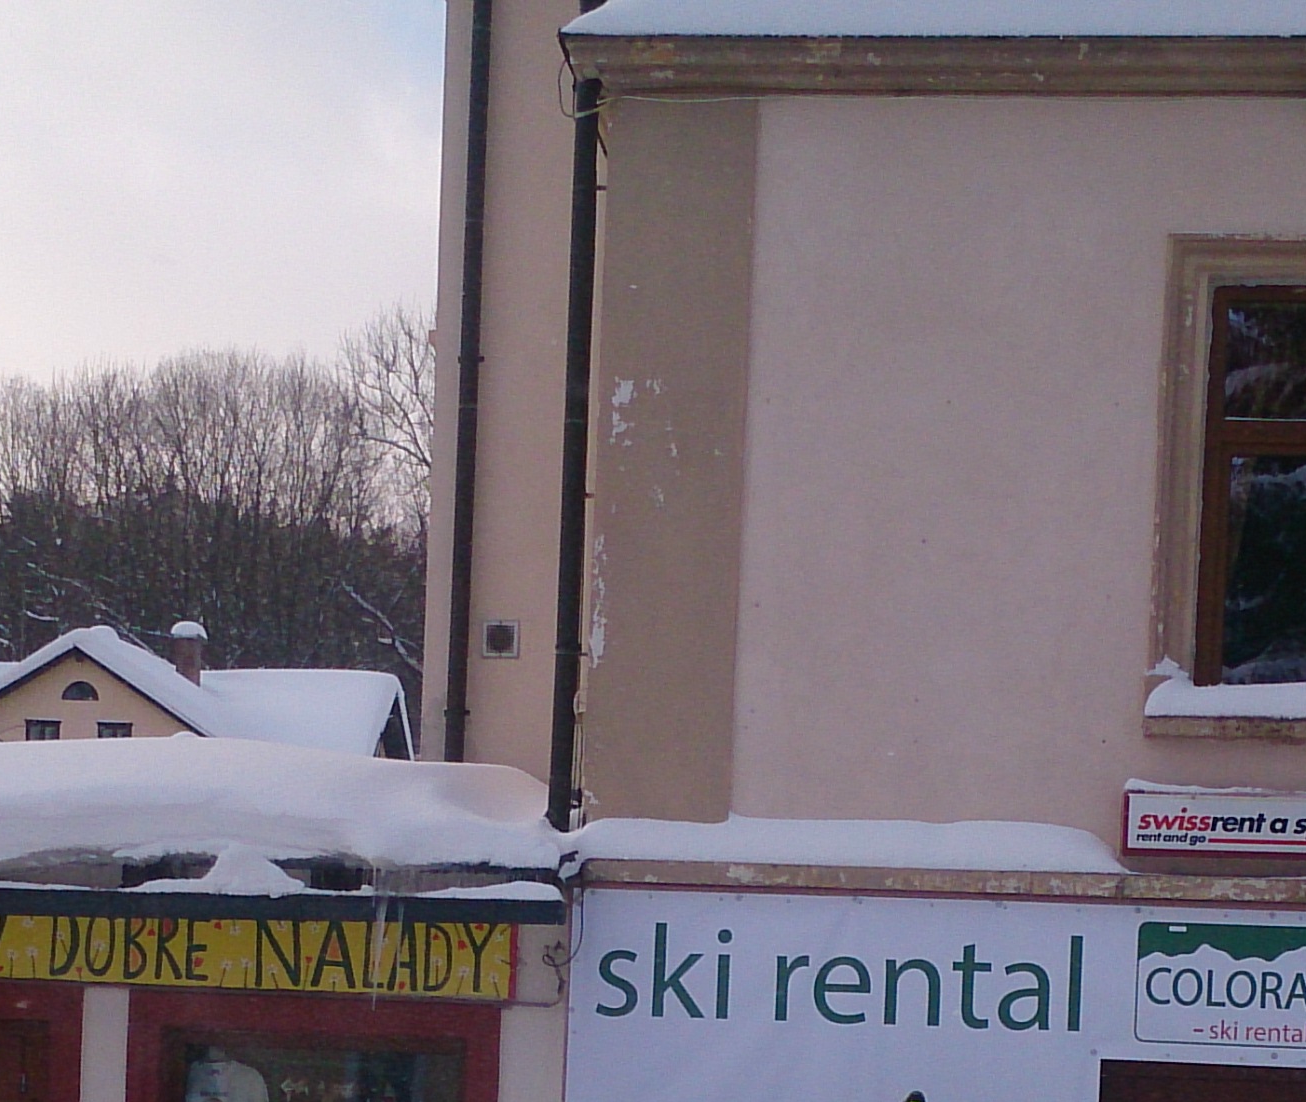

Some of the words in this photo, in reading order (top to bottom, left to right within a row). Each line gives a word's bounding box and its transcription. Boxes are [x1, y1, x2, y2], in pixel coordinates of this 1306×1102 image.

[1137, 806, 1266, 833] swissrent
[1269, 816, 1289, 834] a
[1136, 832, 1163, 843] rent
[1163, 833, 1188, 844] and
[1189, 836, 1207, 846] go
[595, 921, 733, 1020] ski
[773, 935, 1084, 1032] rental
